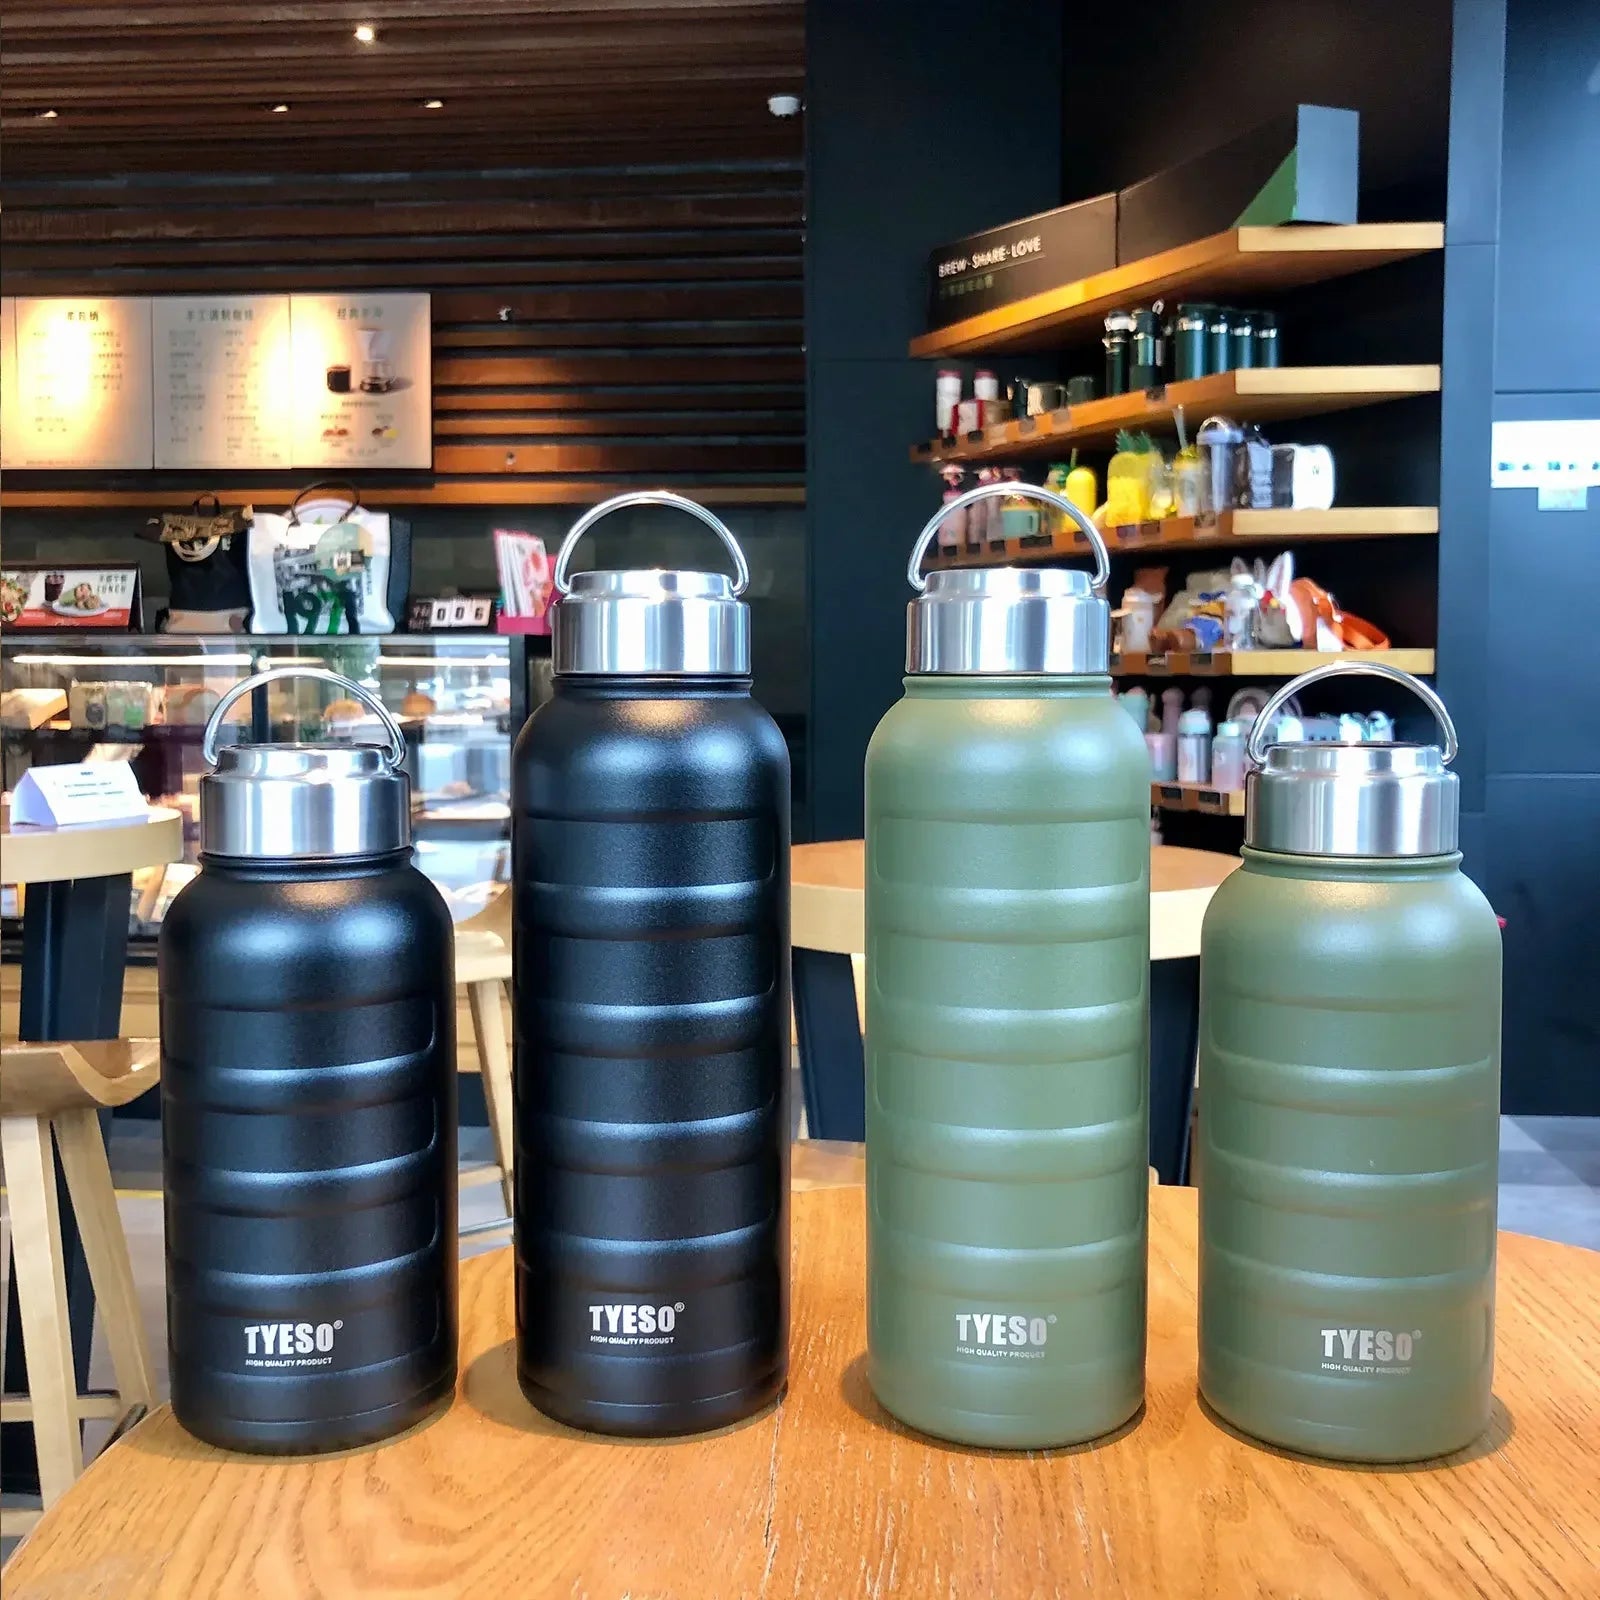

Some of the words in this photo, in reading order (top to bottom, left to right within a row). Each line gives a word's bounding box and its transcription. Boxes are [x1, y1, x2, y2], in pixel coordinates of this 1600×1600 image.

[938, 259, 967, 278] BREW
[1011, 236, 1042, 258] LOVE
[590, 1335, 608, 1344] HIGH
[608, 1337, 638, 1345] QUALITY
[639, 1337, 675, 1345] PRODUCT
[956, 1346, 975, 1354] HIGH
[976, 1348, 1008, 1358] QUALITY
[245, 1359, 264, 1367] HIGH
[264, 1359, 296, 1368] QUALITY
[296, 1357, 333, 1366] PRODUCT
[1321, 1362, 1341, 1370] HIGH
[1342, 1364, 1375, 1373] QUALITY
